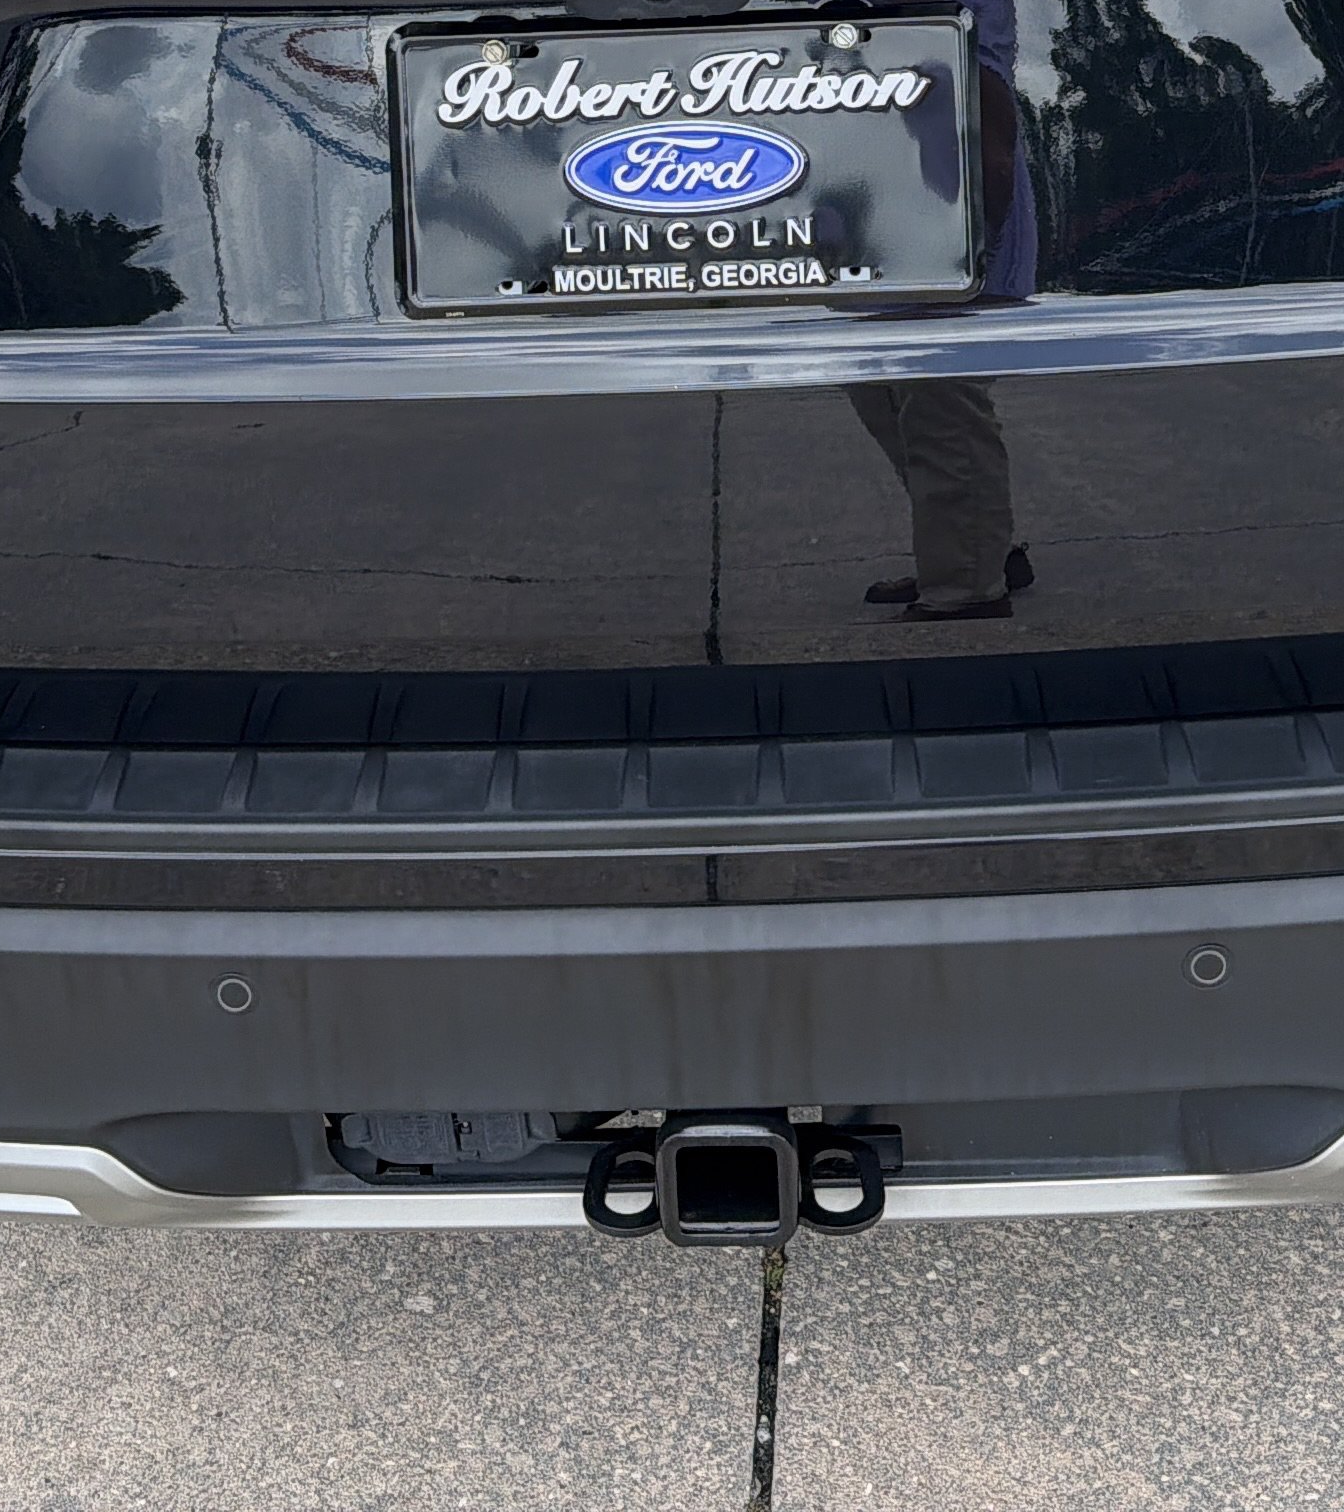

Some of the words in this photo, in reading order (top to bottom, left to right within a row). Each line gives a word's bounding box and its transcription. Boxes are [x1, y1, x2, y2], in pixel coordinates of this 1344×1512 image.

[438, 58, 679, 123] Robert
[679, 50, 932, 114] Hutson
[613, 136, 756, 191] Ford
[564, 216, 813, 254] LINCOLN
[554, 265, 696, 292] MOULTRIE,
[701, 260, 829, 288] GEORGIA
